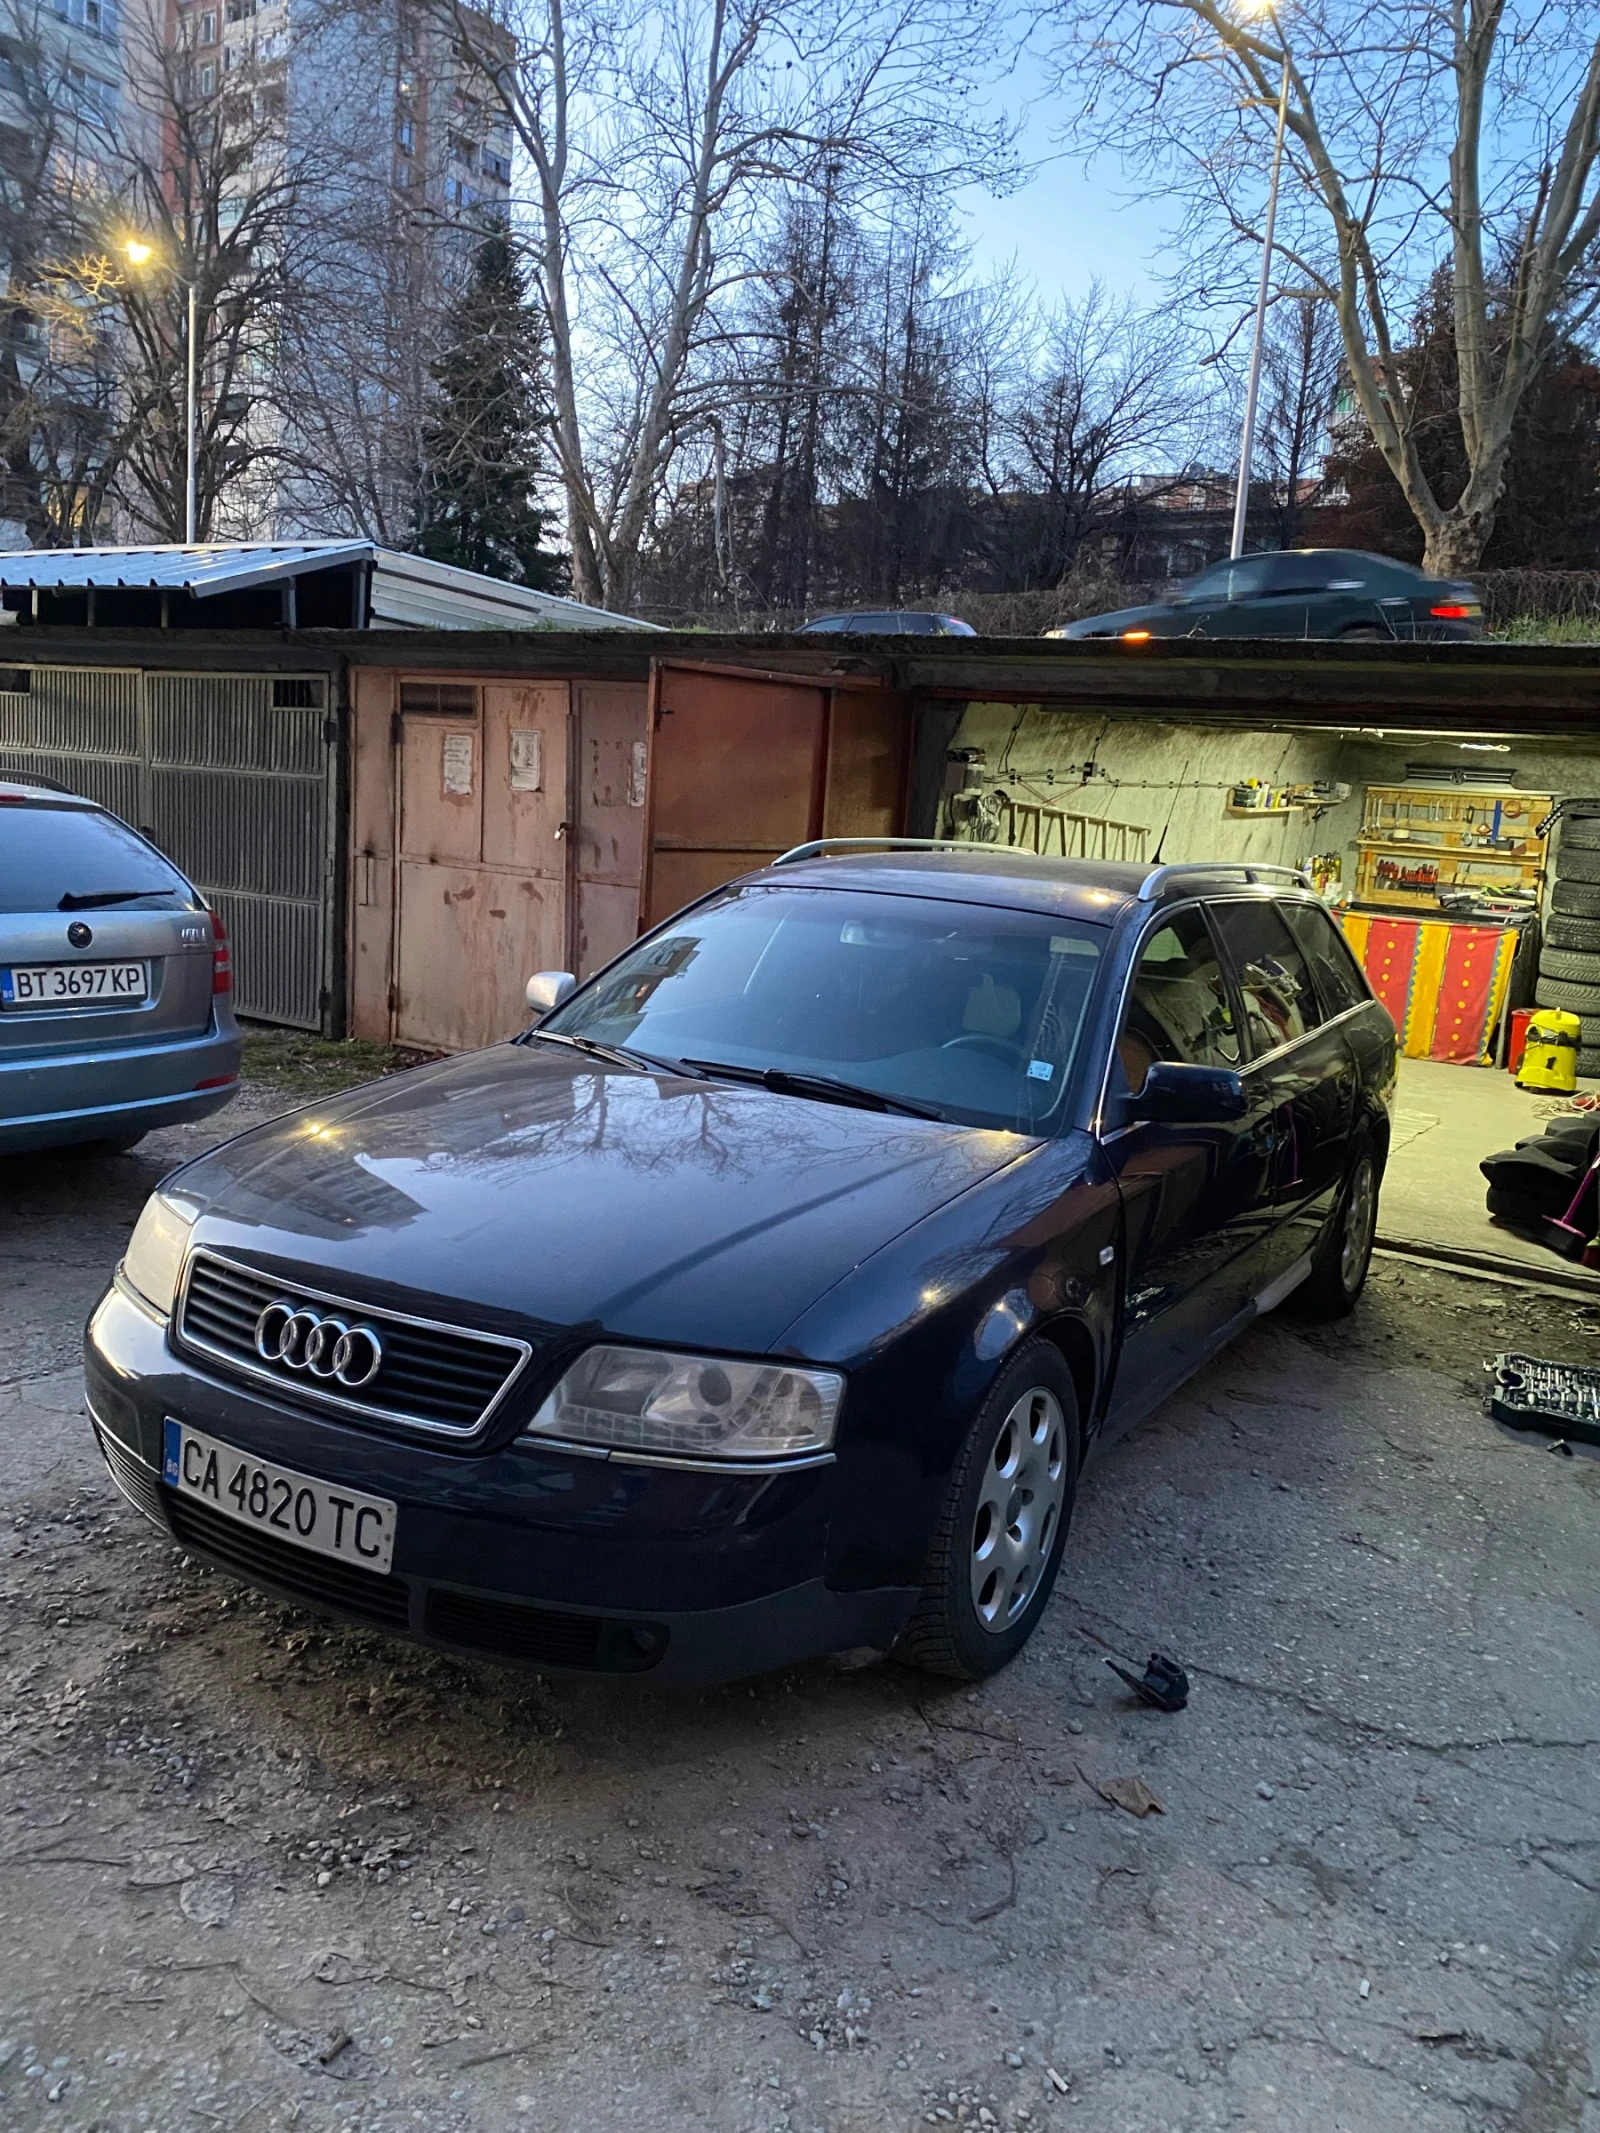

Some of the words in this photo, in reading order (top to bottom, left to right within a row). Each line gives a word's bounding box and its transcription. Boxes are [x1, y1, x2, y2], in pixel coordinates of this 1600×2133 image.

[18, 972, 47, 998] BT
[54, 969, 107, 995] 3697
[112, 968, 140, 992] KP
[166, 1459, 179, 1476] BG
[183, 1438, 219, 1499] CA
[228, 1462, 316, 1536] 4820
[328, 1495, 383, 1558] TC
